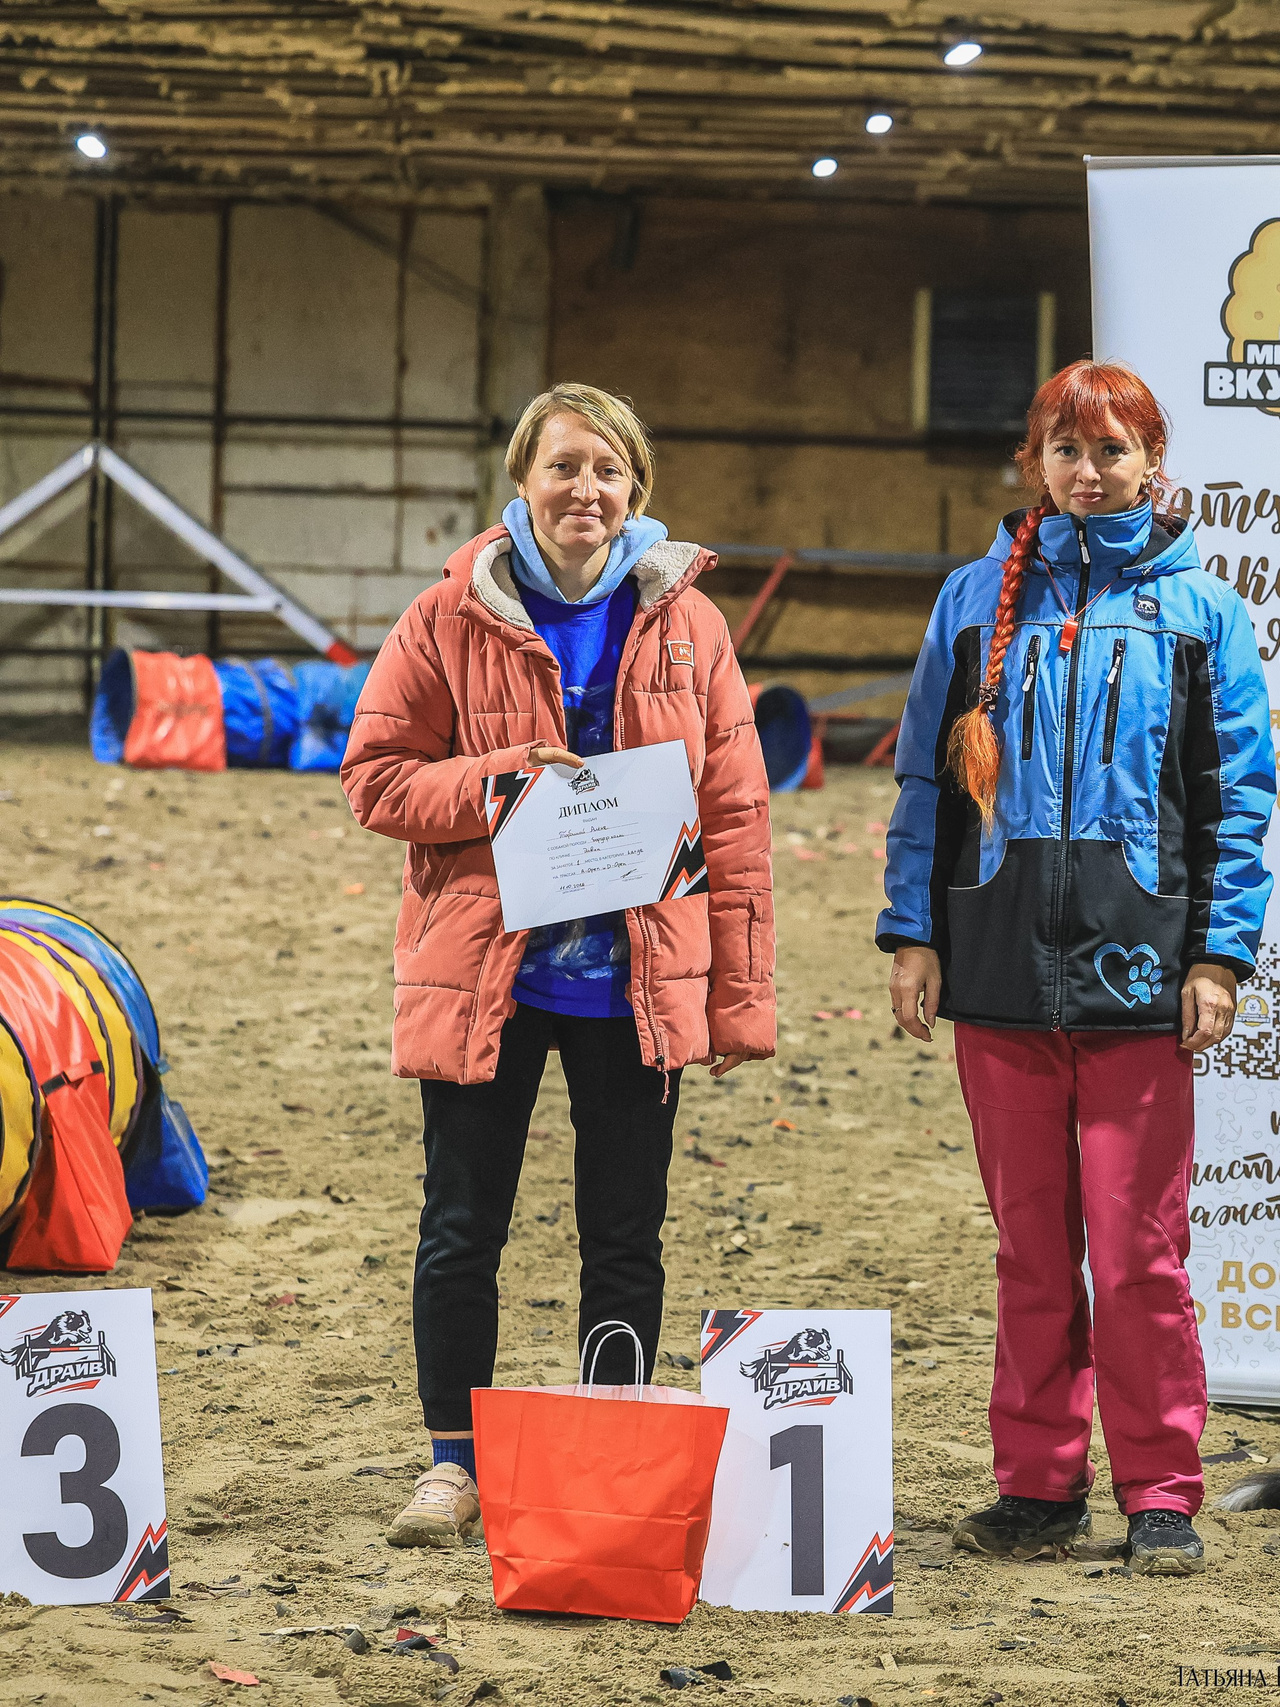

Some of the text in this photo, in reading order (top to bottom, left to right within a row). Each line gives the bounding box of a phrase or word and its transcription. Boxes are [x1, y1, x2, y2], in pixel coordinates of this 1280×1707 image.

[558, 797, 619, 820] ДИПЛОМ
[20, 1402, 129, 1580] 3
[770, 1424, 825, 1596] 1
